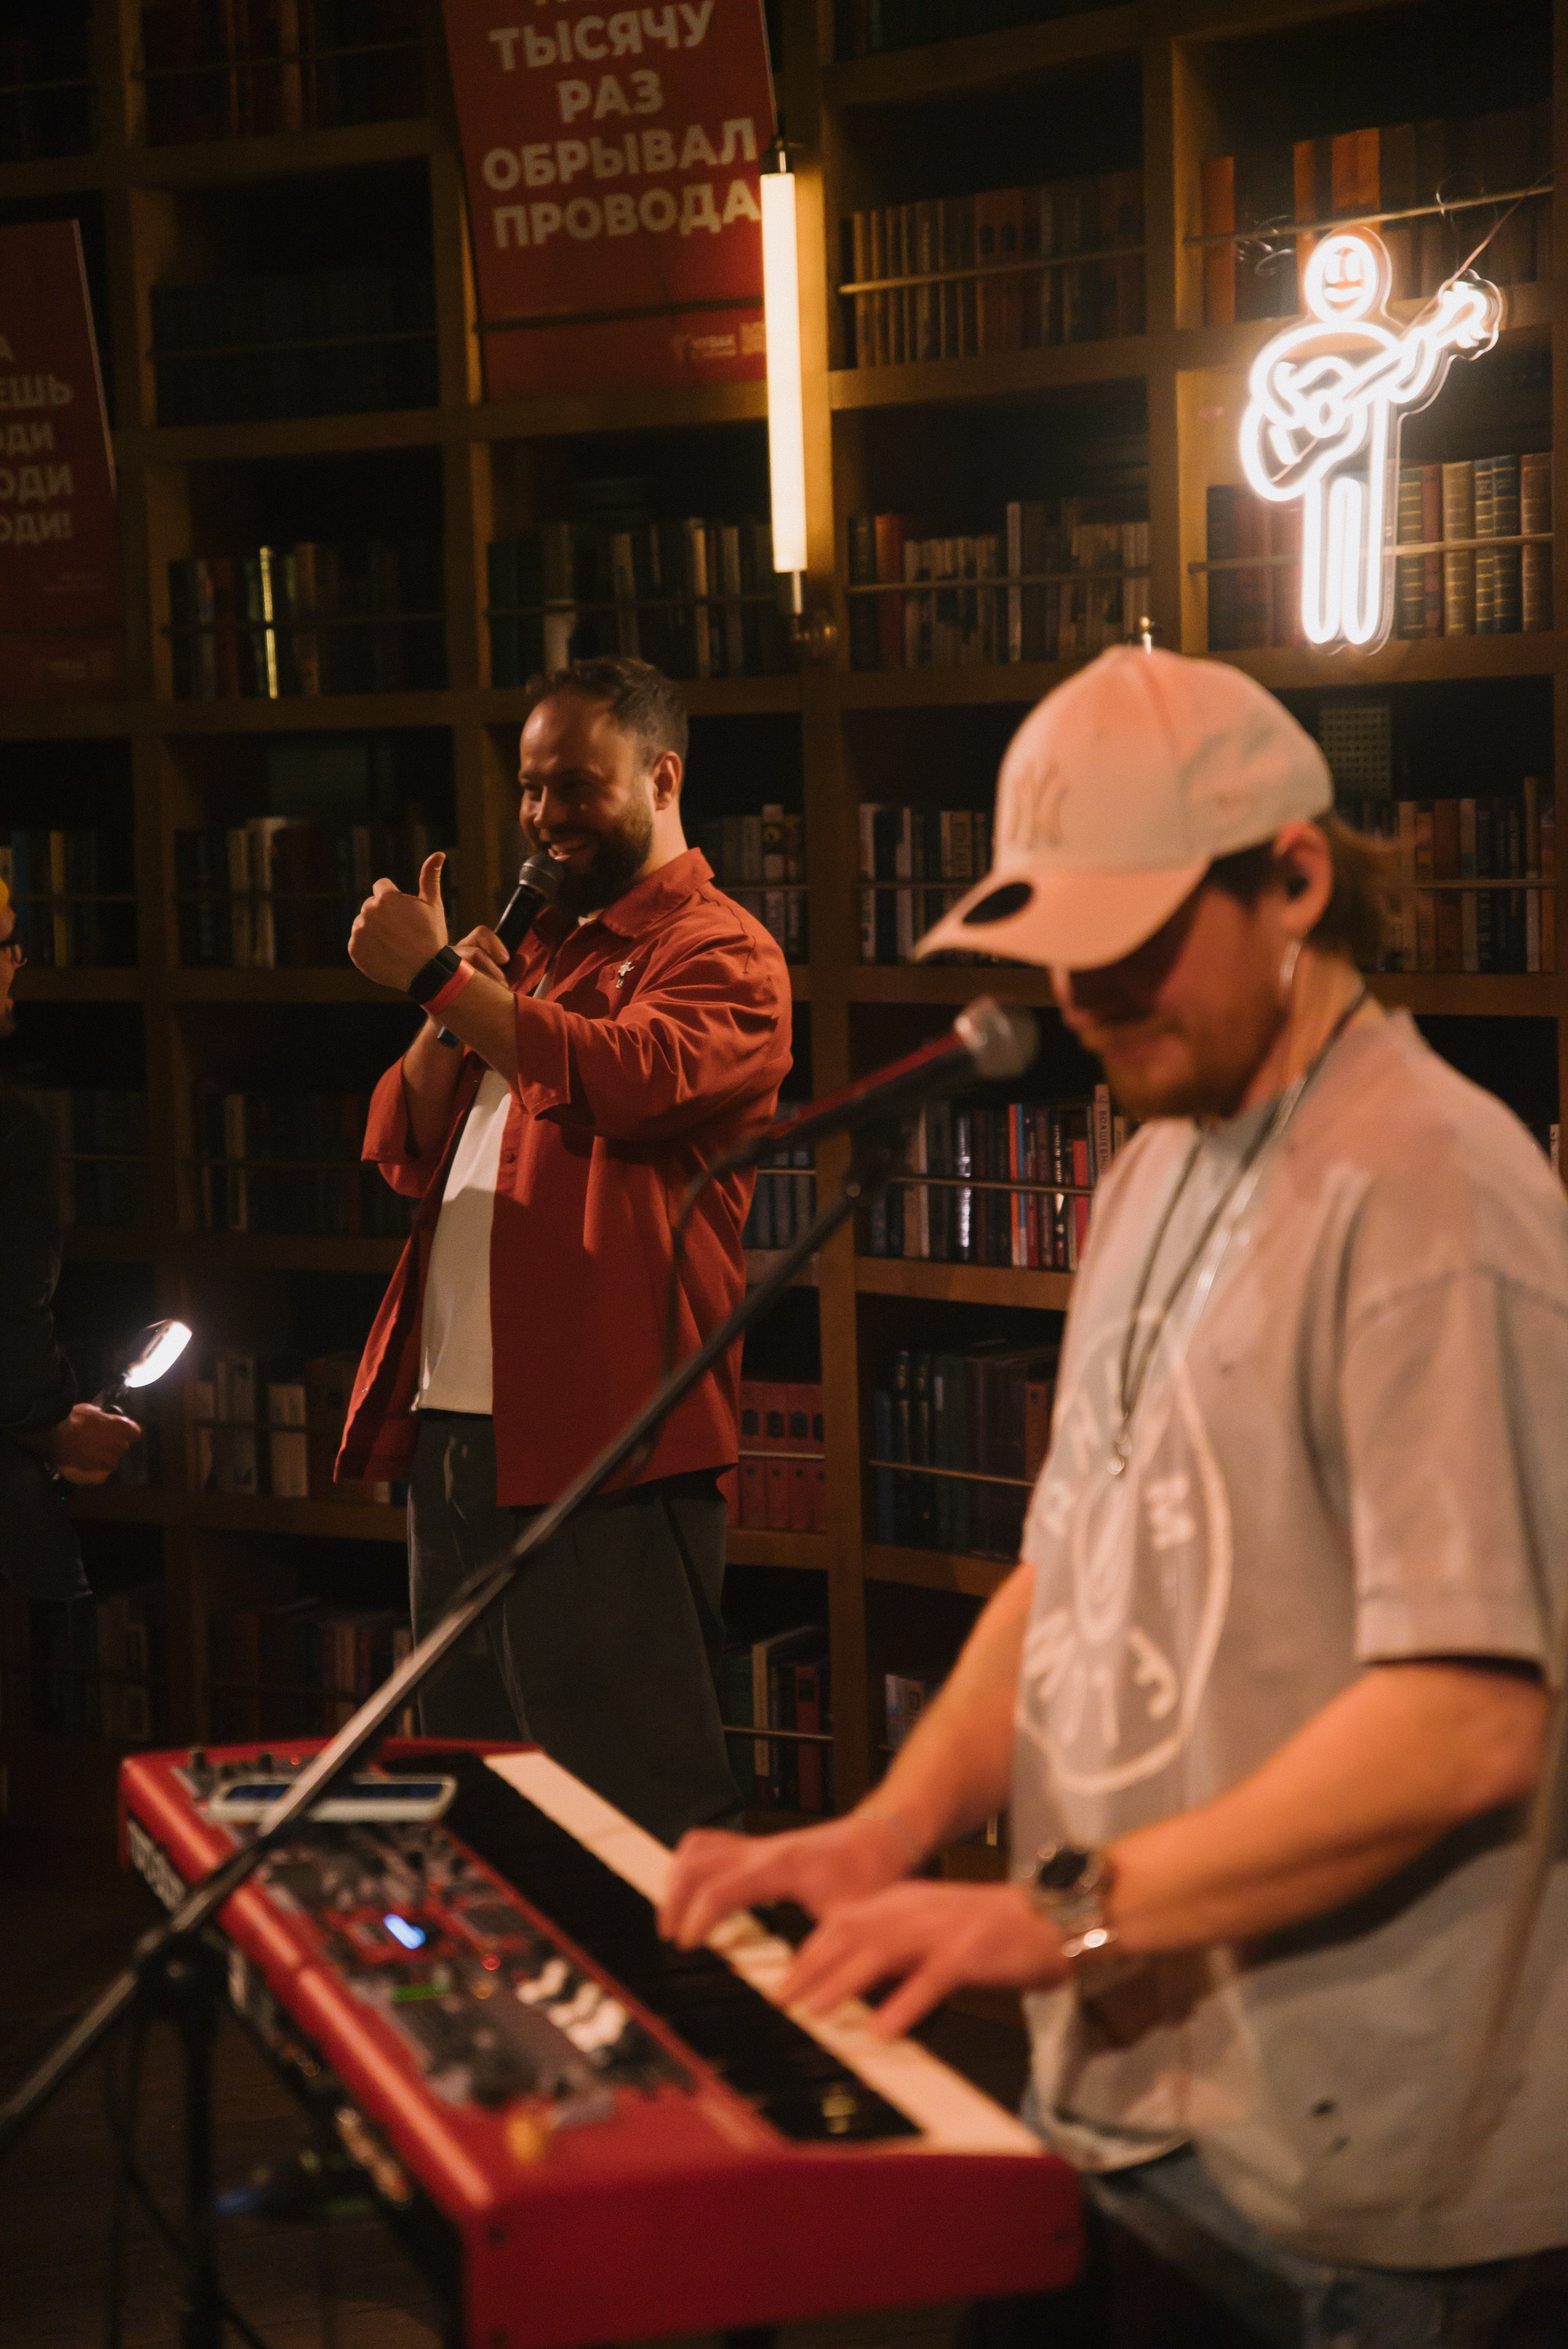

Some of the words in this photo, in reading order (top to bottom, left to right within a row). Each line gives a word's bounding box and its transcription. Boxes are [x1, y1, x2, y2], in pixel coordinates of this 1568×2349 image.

[488, 0, 715, 70] ТЫСЯЧУ
[557, 69, 665, 123] РАЗ
[483, 117, 758, 191] ОБРЫВАЛ
[492, 179, 761, 248] ПРОВОДА
[0, 421, 55, 457] ДИ
